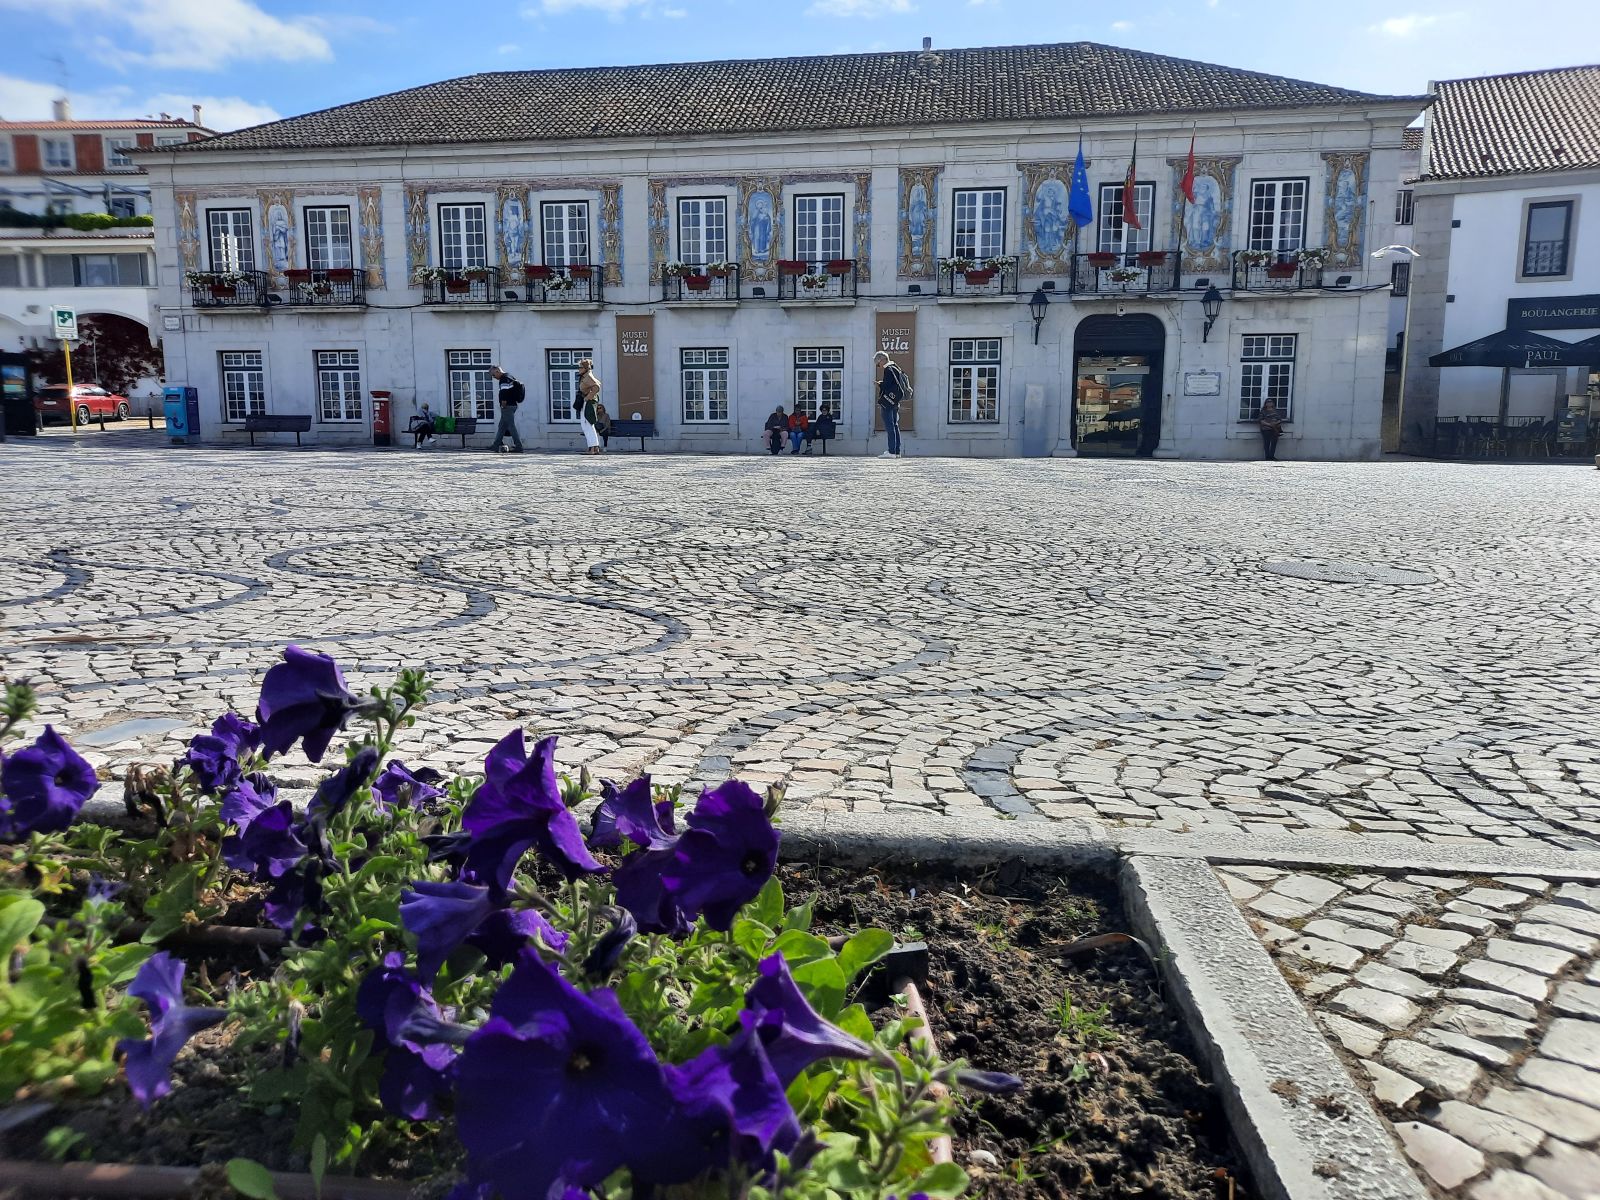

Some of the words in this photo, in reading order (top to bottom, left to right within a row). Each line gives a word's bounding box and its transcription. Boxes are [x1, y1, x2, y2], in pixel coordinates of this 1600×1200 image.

[1521, 307, 1598, 318] BOULANGERIE
[622, 331, 648, 339] MUSEU
[881, 328, 910, 336] MUSEU
[622, 340, 648, 353] vila
[881, 337, 909, 351] vila
[1527, 350, 1561, 361] PAUL
